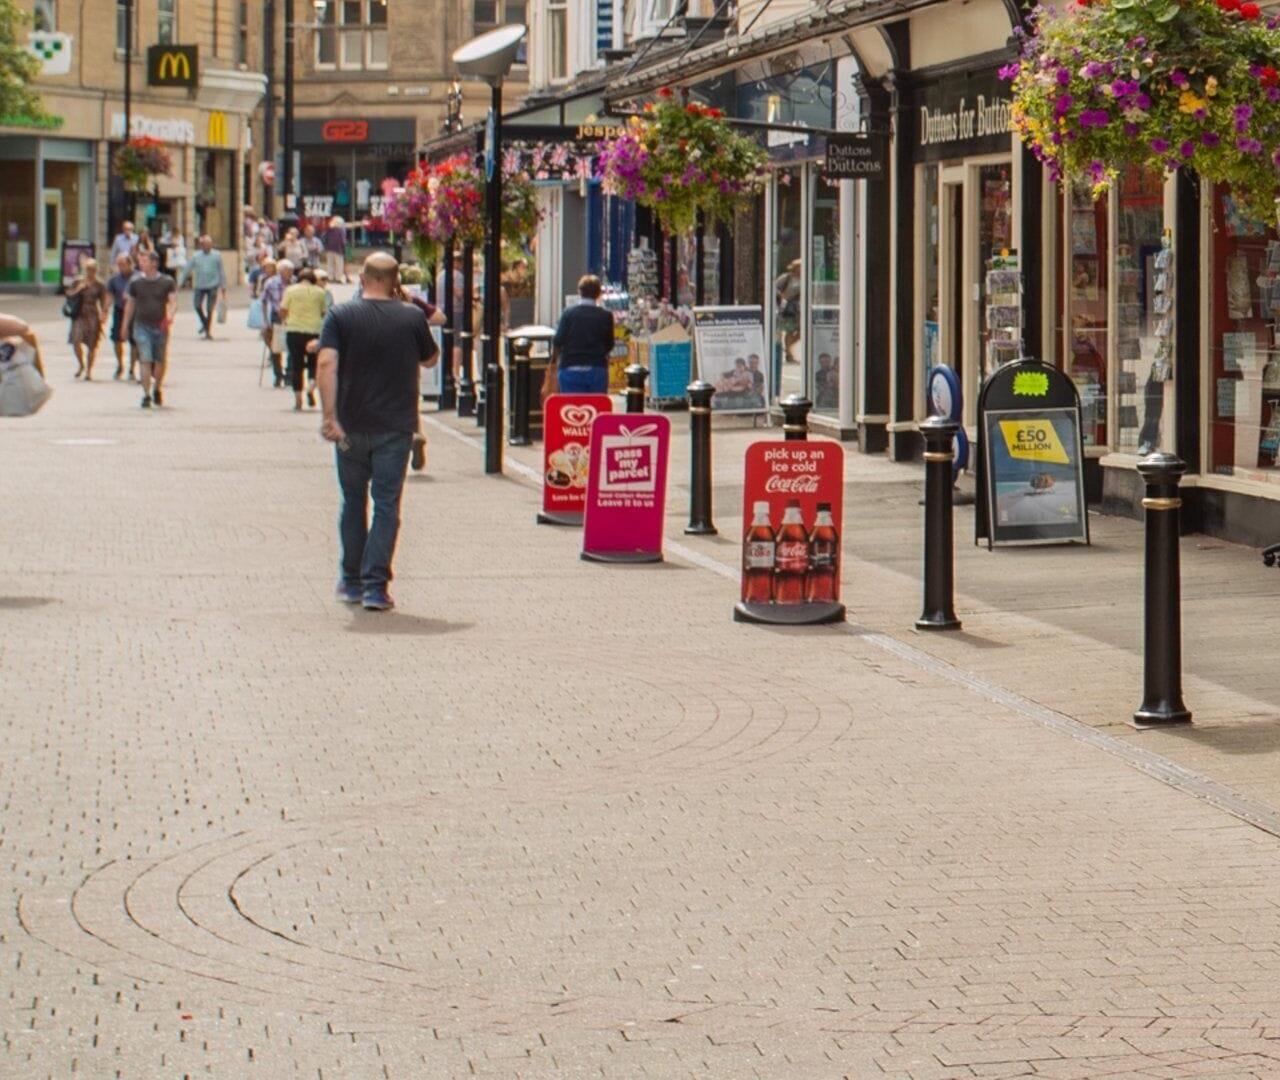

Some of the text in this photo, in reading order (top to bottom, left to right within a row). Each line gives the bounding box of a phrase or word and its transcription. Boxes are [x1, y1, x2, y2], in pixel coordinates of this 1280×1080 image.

[959, 97, 975, 140] for
[828, 158, 881, 173] Buttons
[1015, 428, 1047, 443] £50
[1012, 441, 1051, 452] MILLION
[614, 448, 643, 462] pass
[764, 448, 825, 461] pick up an
[619, 459, 639, 470] my
[771, 460, 817, 472] ice cold
[608, 466, 649, 483] parcel
[597, 499, 655, 508] Leave it to us
